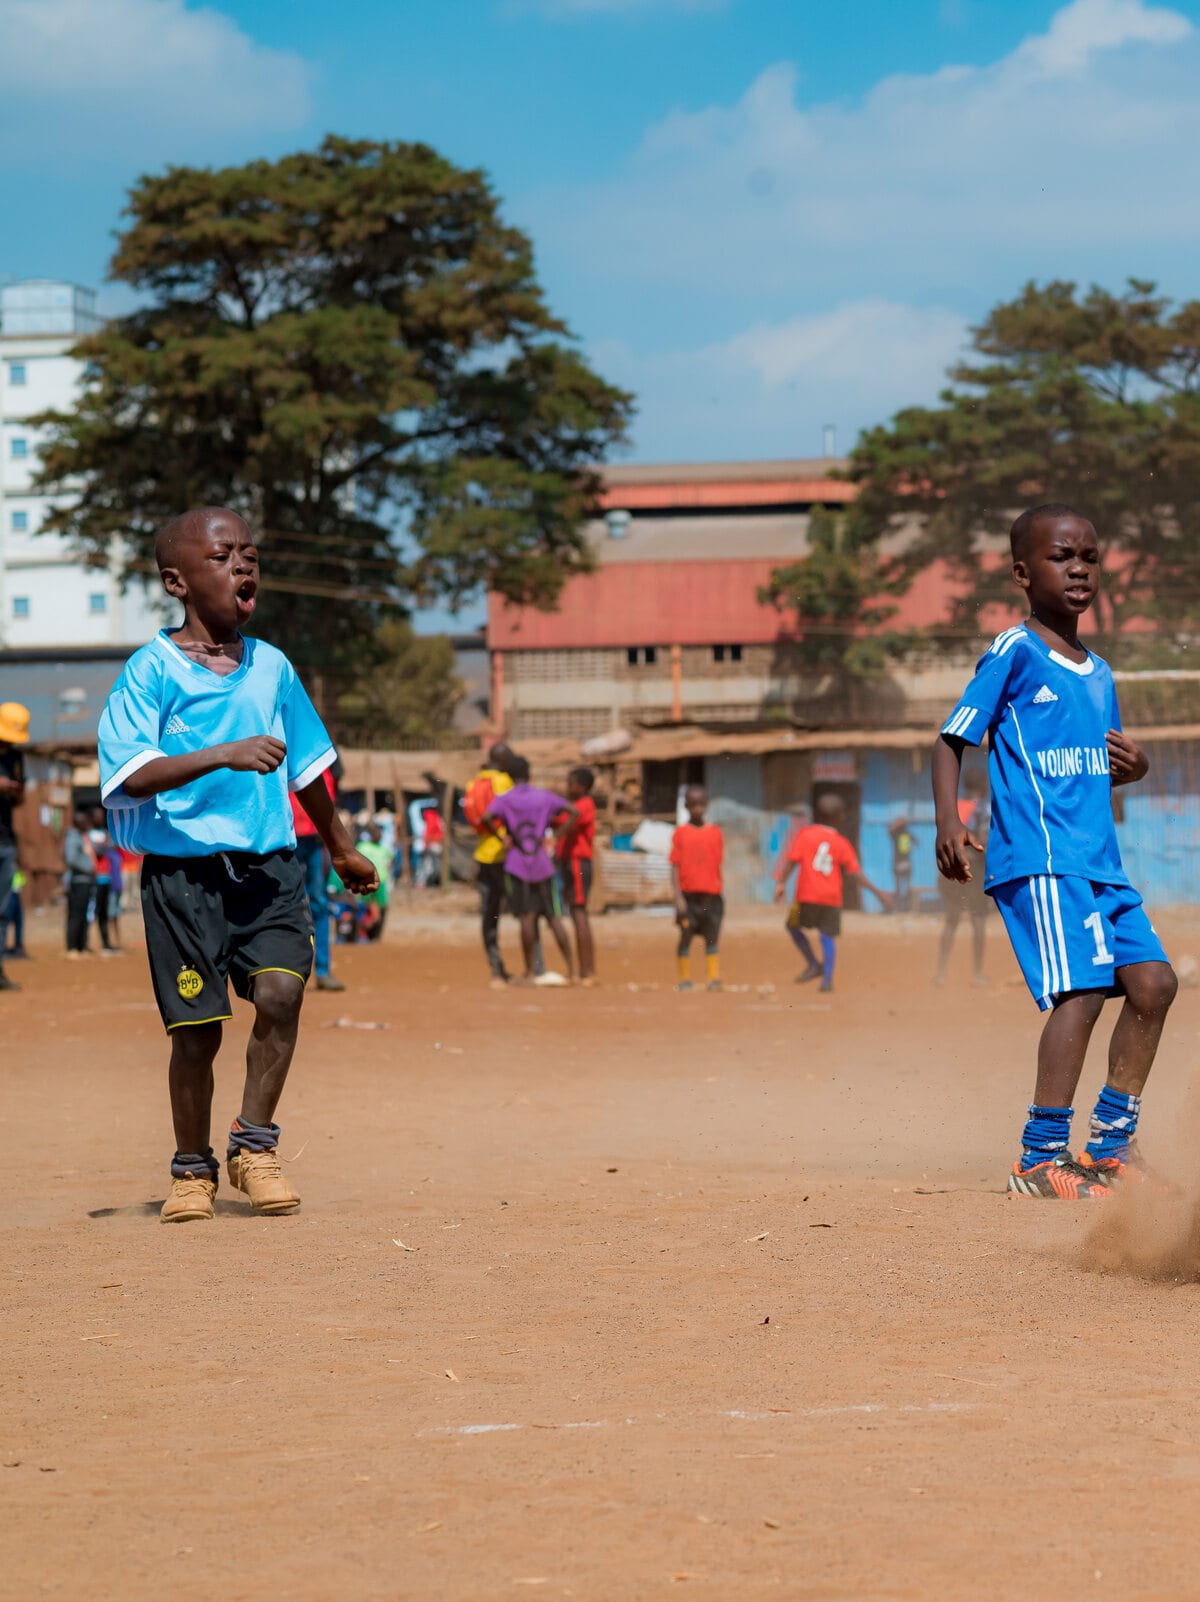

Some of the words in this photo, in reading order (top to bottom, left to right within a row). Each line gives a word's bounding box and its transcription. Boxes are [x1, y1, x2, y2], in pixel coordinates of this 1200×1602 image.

[1036, 746, 1083, 778] YOUNG
[1083, 747, 1110, 775] TAL
[812, 841, 834, 877] 4
[1083, 911, 1115, 966] 1
[180, 974, 199, 990] BVB
